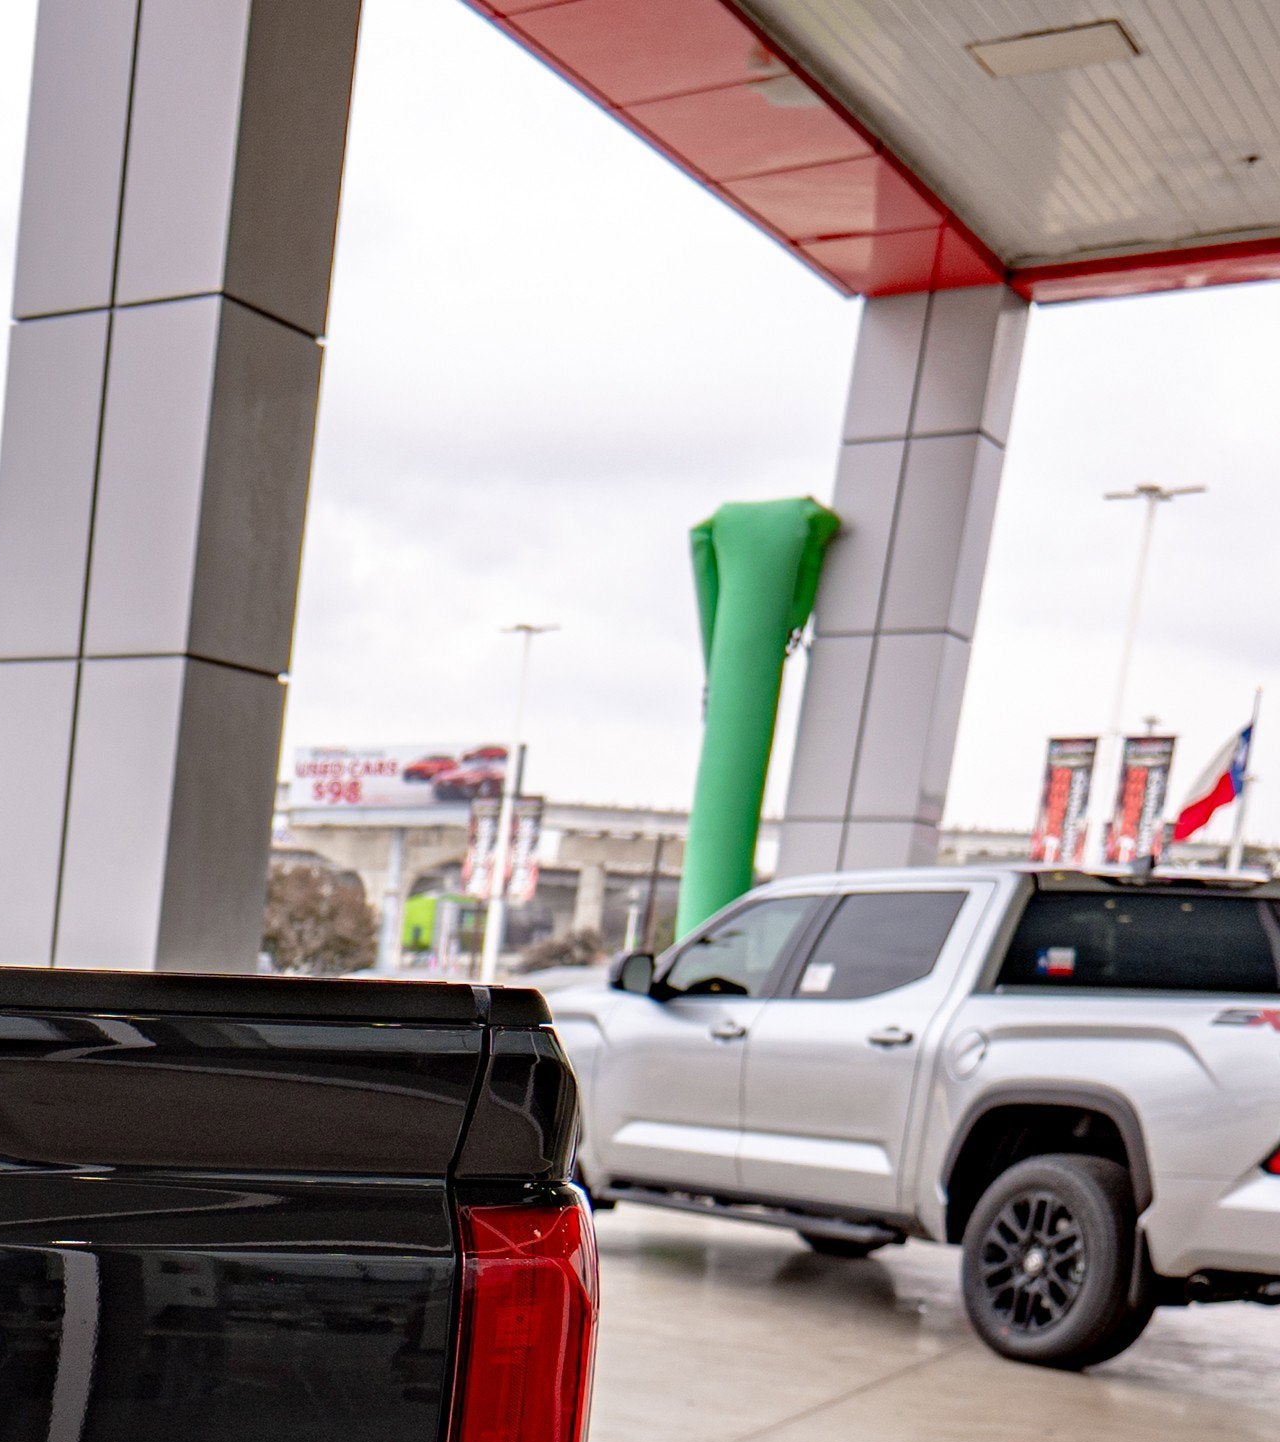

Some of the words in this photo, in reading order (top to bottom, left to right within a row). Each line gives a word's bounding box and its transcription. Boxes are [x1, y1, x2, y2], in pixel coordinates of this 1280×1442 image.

[296, 760, 344, 777] USED
[349, 758, 399, 777] CARS
[313, 780, 361, 803] $98
